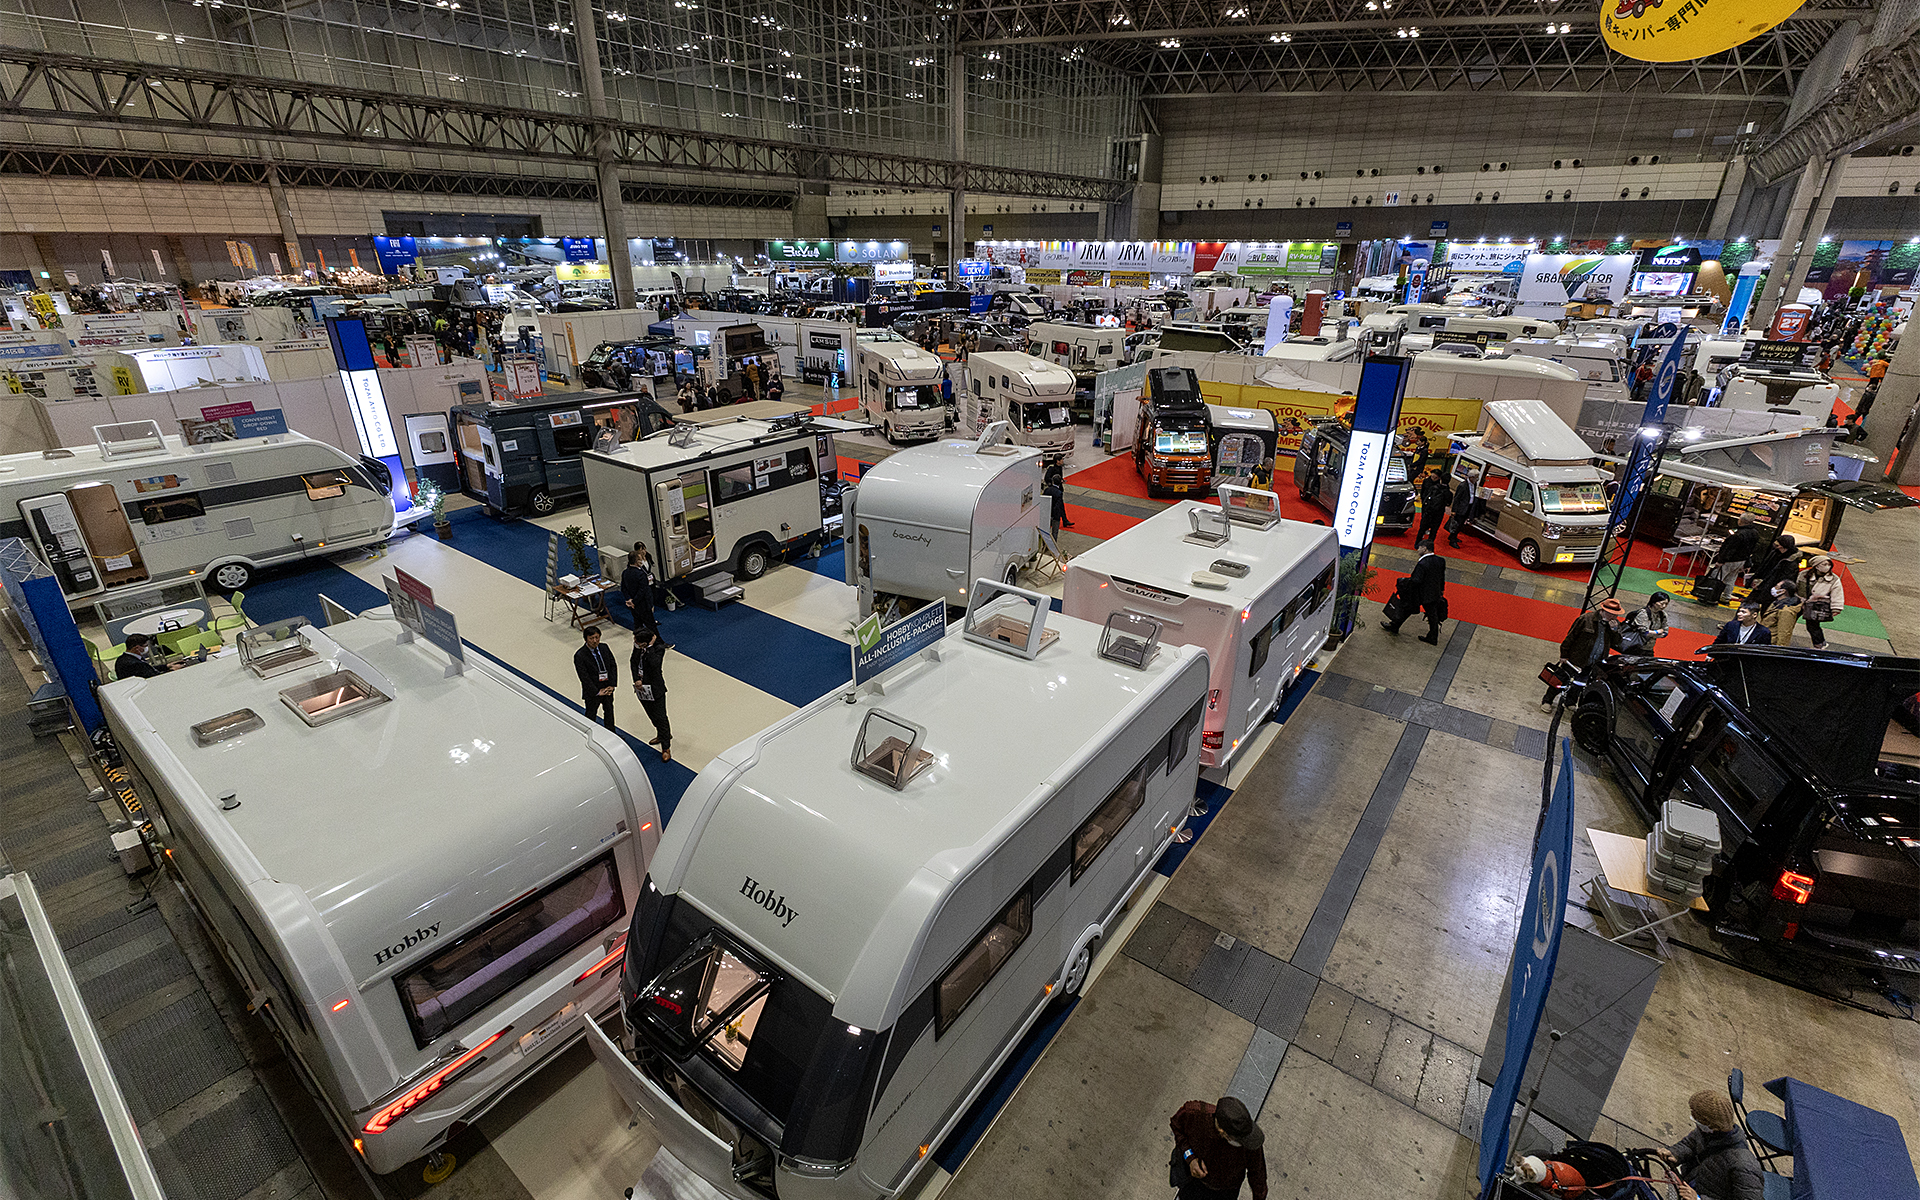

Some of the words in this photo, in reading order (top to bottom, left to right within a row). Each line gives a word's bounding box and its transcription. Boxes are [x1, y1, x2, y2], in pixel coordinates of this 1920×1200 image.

[862, 249, 899, 258] SOLAN
[1080, 244, 1106, 260] JRVA
[1117, 245, 1146, 260] JRVA
[1652, 257, 1682, 266] NUTS
[1535, 272, 1614, 284] GRANDMOTOR
[1780, 318, 1801, 329] 27
[117, 376, 129, 387] RV
[241, 415, 276, 424] CONVENIENT
[242, 421, 278, 429] DROP-DOWN
[1418, 416, 1444, 432] ONE
[892, 529, 932, 547] beachy
[1125, 586, 1171, 602] SWIFT
[121, 601, 152, 612] Hobby
[858, 614, 943, 668] ALL-INCLUSIVE-PACKAGE
[738, 876, 799, 928] Hobby
[373, 921, 442, 967] Hobby
